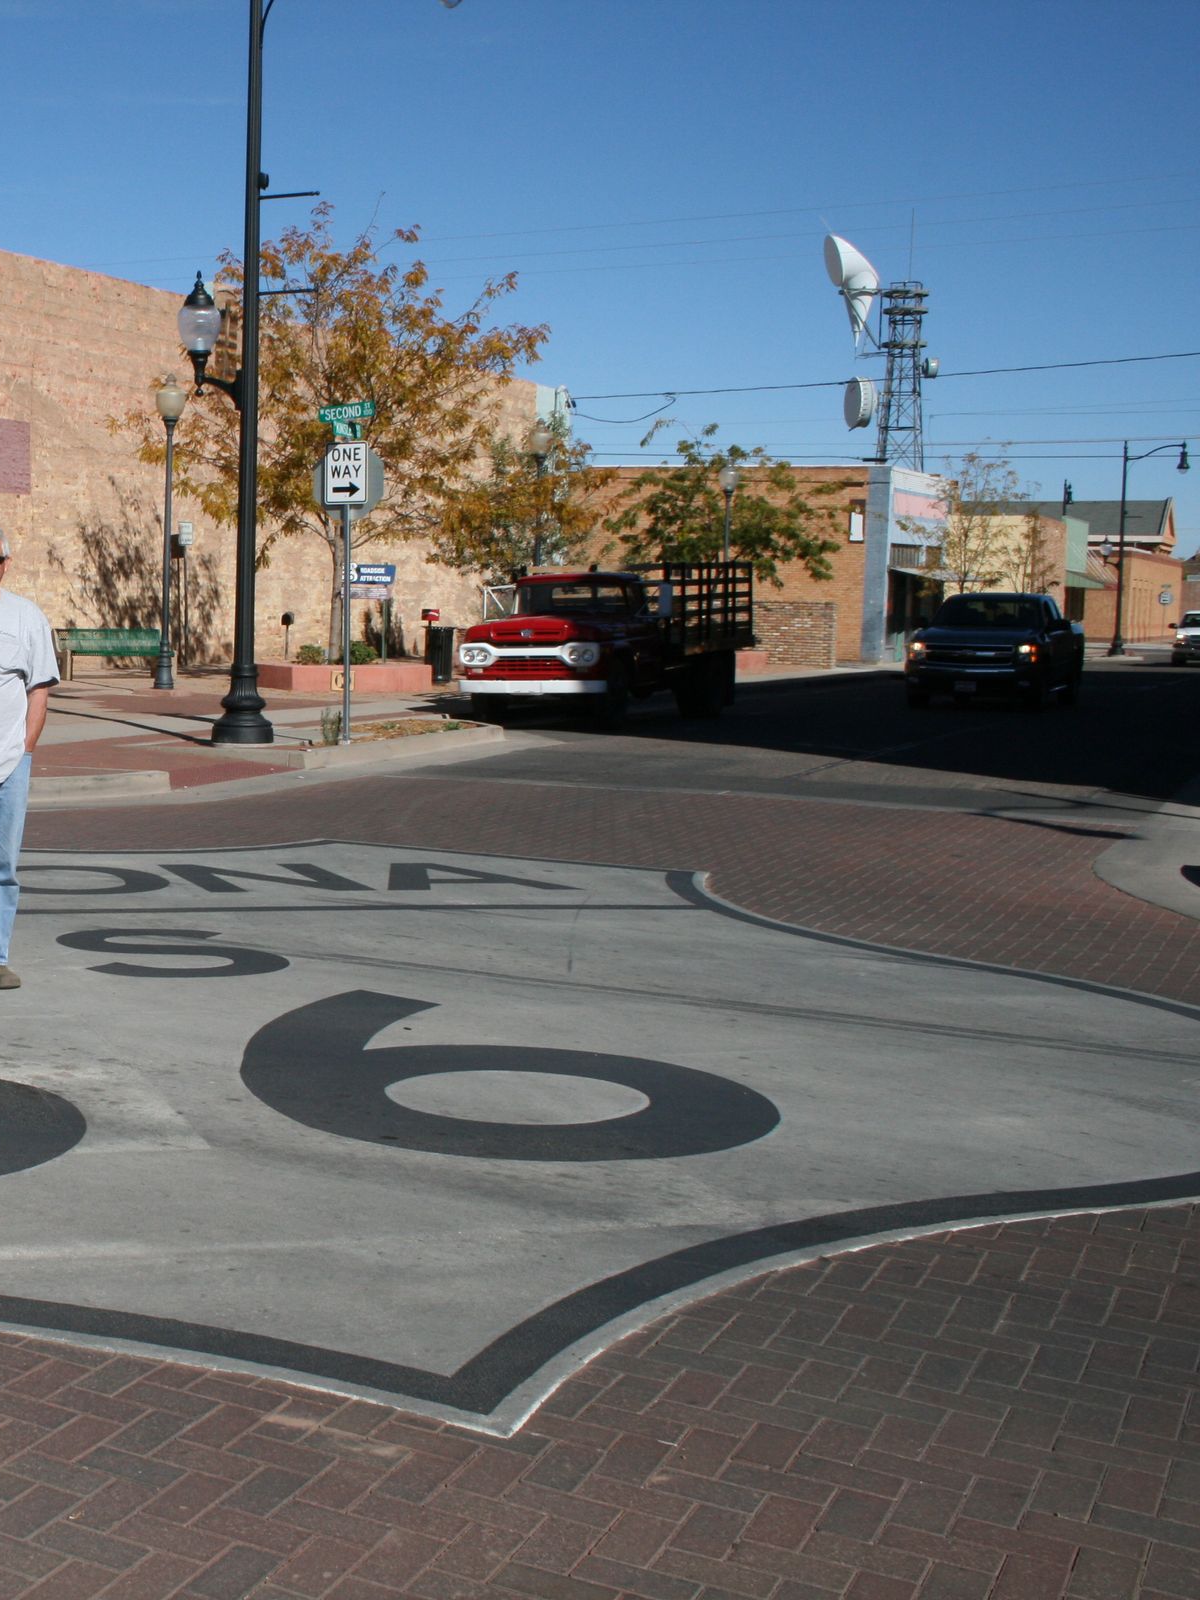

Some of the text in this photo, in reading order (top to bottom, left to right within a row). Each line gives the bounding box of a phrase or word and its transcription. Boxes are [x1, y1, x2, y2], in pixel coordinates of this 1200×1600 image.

[325, 405, 361, 420] SECOND
[332, 447, 362, 462] ONE
[331, 464, 362, 479] WAY
